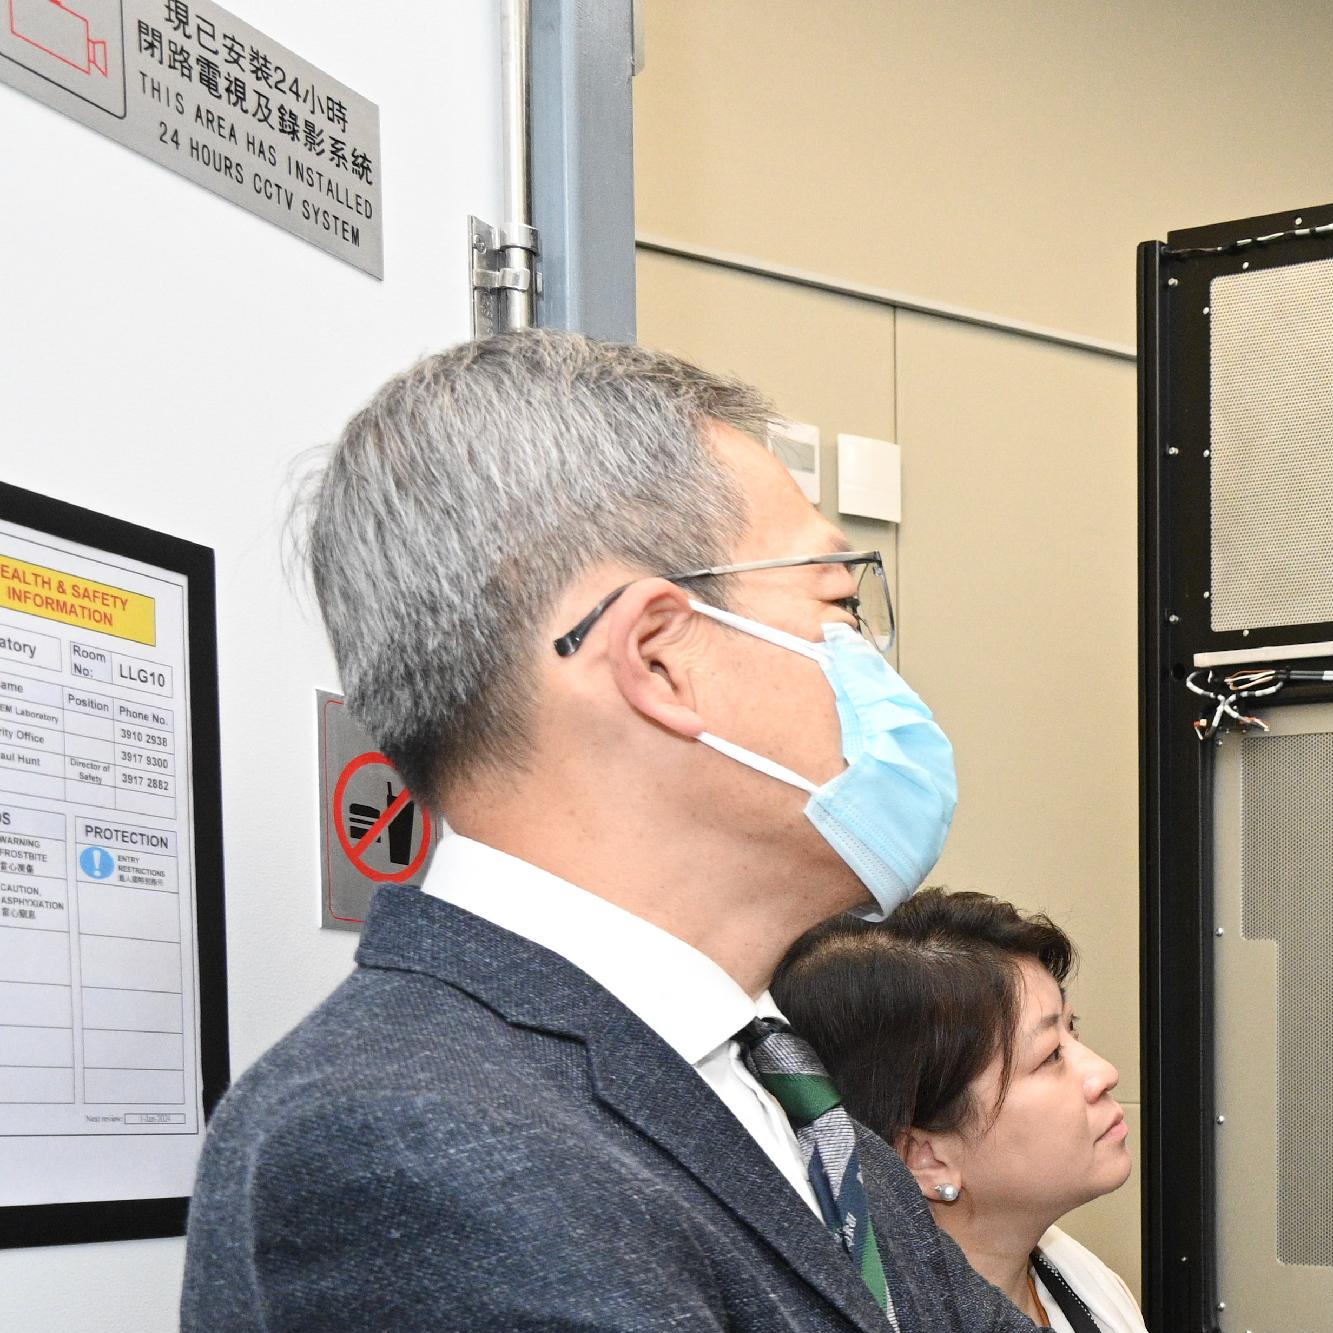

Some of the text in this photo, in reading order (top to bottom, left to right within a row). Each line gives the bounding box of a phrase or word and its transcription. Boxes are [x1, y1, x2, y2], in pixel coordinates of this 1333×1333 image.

[163, 0, 349, 134] 現已安裝24小時
[139, 70, 373, 220] THIS AREA HAS INSTALLED
[159, 121, 360, 248] 24 HOURS CCTV SYSTEM
[56, 580, 67, 595] &
[72, 584, 129, 611] SAFETY
[8, 586, 114, 626] INFORMATION
[74, 644, 106, 663] Room
[120, 663, 165, 687] LLG10
[68, 693, 109, 712] Position
[16, 707, 59, 724] Laboratory
[120, 706, 149, 721] Phone
[16, 730, 45, 744] Office
[121, 728, 143, 742] 3910
[18, 755, 41, 767] Hunt
[121, 751, 143, 764] 3917
[122, 773, 143, 786] 3917
[84, 824, 169, 850] PROTECTION
[1, 896, 65, 911] ASPHYXIATION
